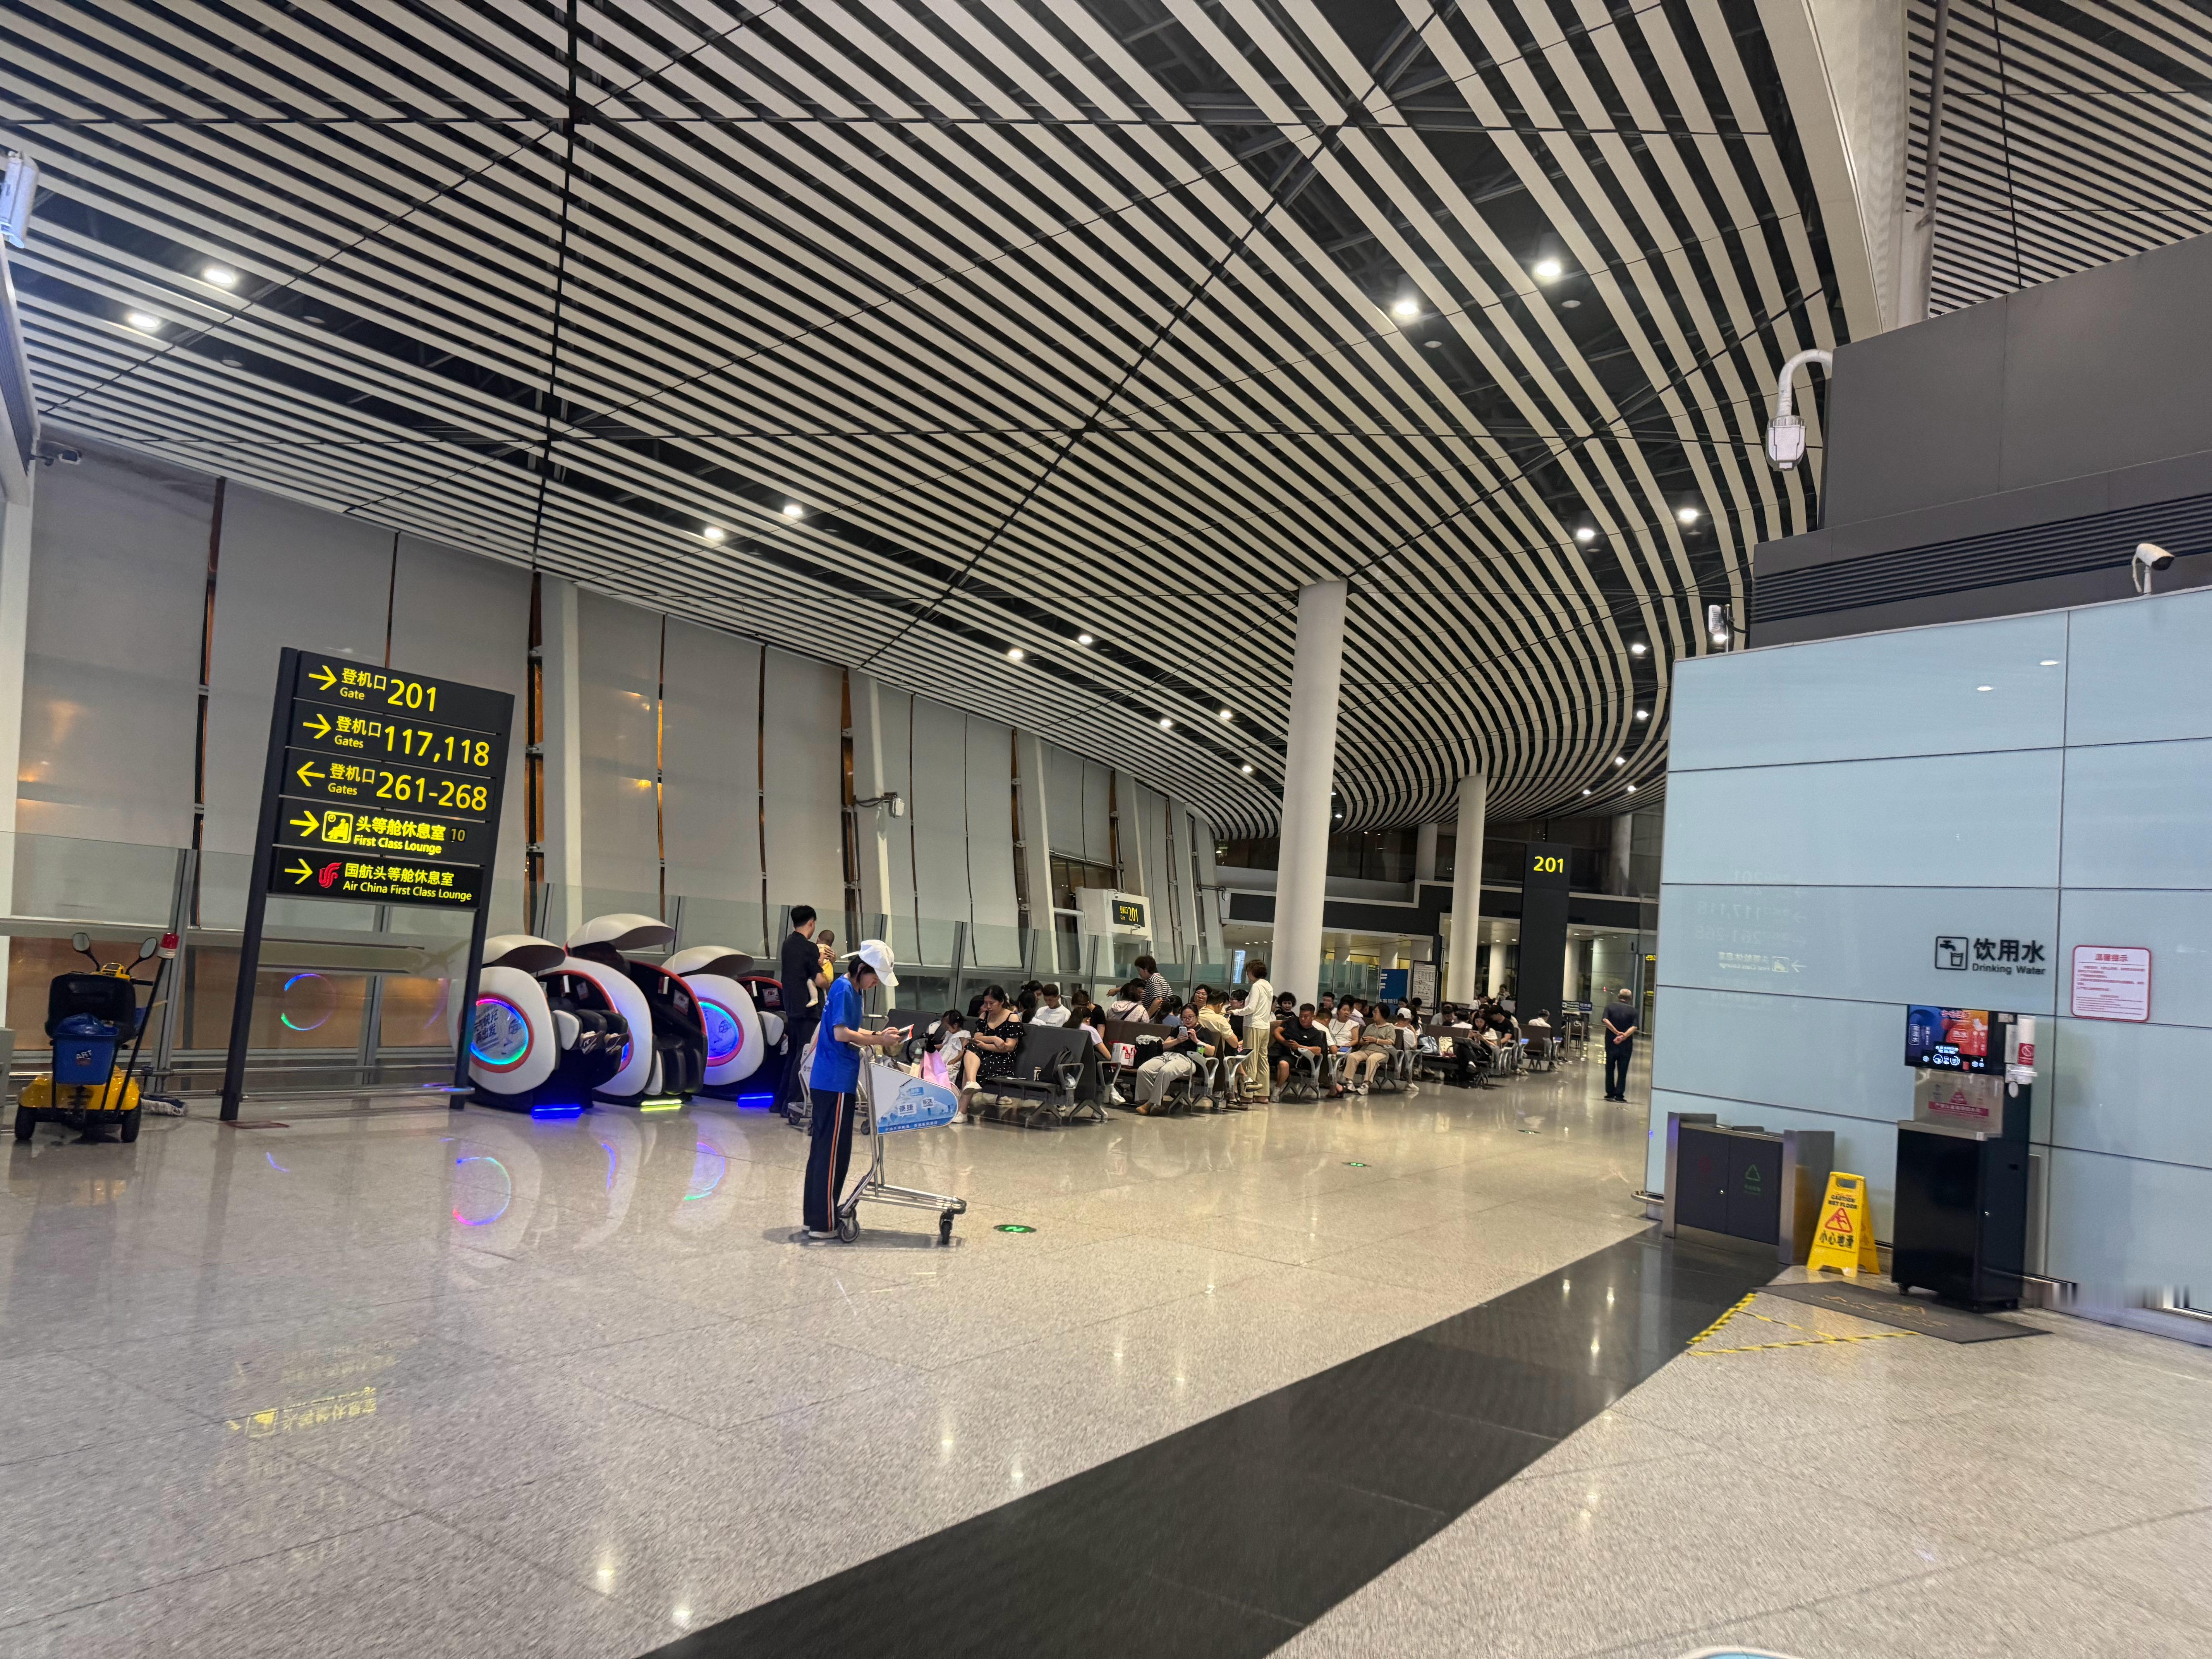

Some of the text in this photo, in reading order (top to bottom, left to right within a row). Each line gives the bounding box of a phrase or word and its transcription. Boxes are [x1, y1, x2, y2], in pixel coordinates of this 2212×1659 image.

[340, 688, 365, 700] Gate
[342, 668, 436, 711] 登机口 201
[335, 735, 363, 748] Gates
[337, 716, 489, 766] 登机口 117,118
[328, 783, 357, 795] Gates
[330, 763, 487, 811] 登机口 261-268
[356, 816, 465, 841] 头等舱休息室 10
[352, 835, 442, 855] First Class Lounge
[345, 863, 454, 886] 国航头等舱休息室
[1534, 856, 1564, 873] 201
[343, 881, 472, 902] Air China First Class Lounge
[1128, 907, 1138, 922] 201
[1973, 938, 2045, 963] 饮用水
[1973, 963, 2046, 975] Drinking Water
